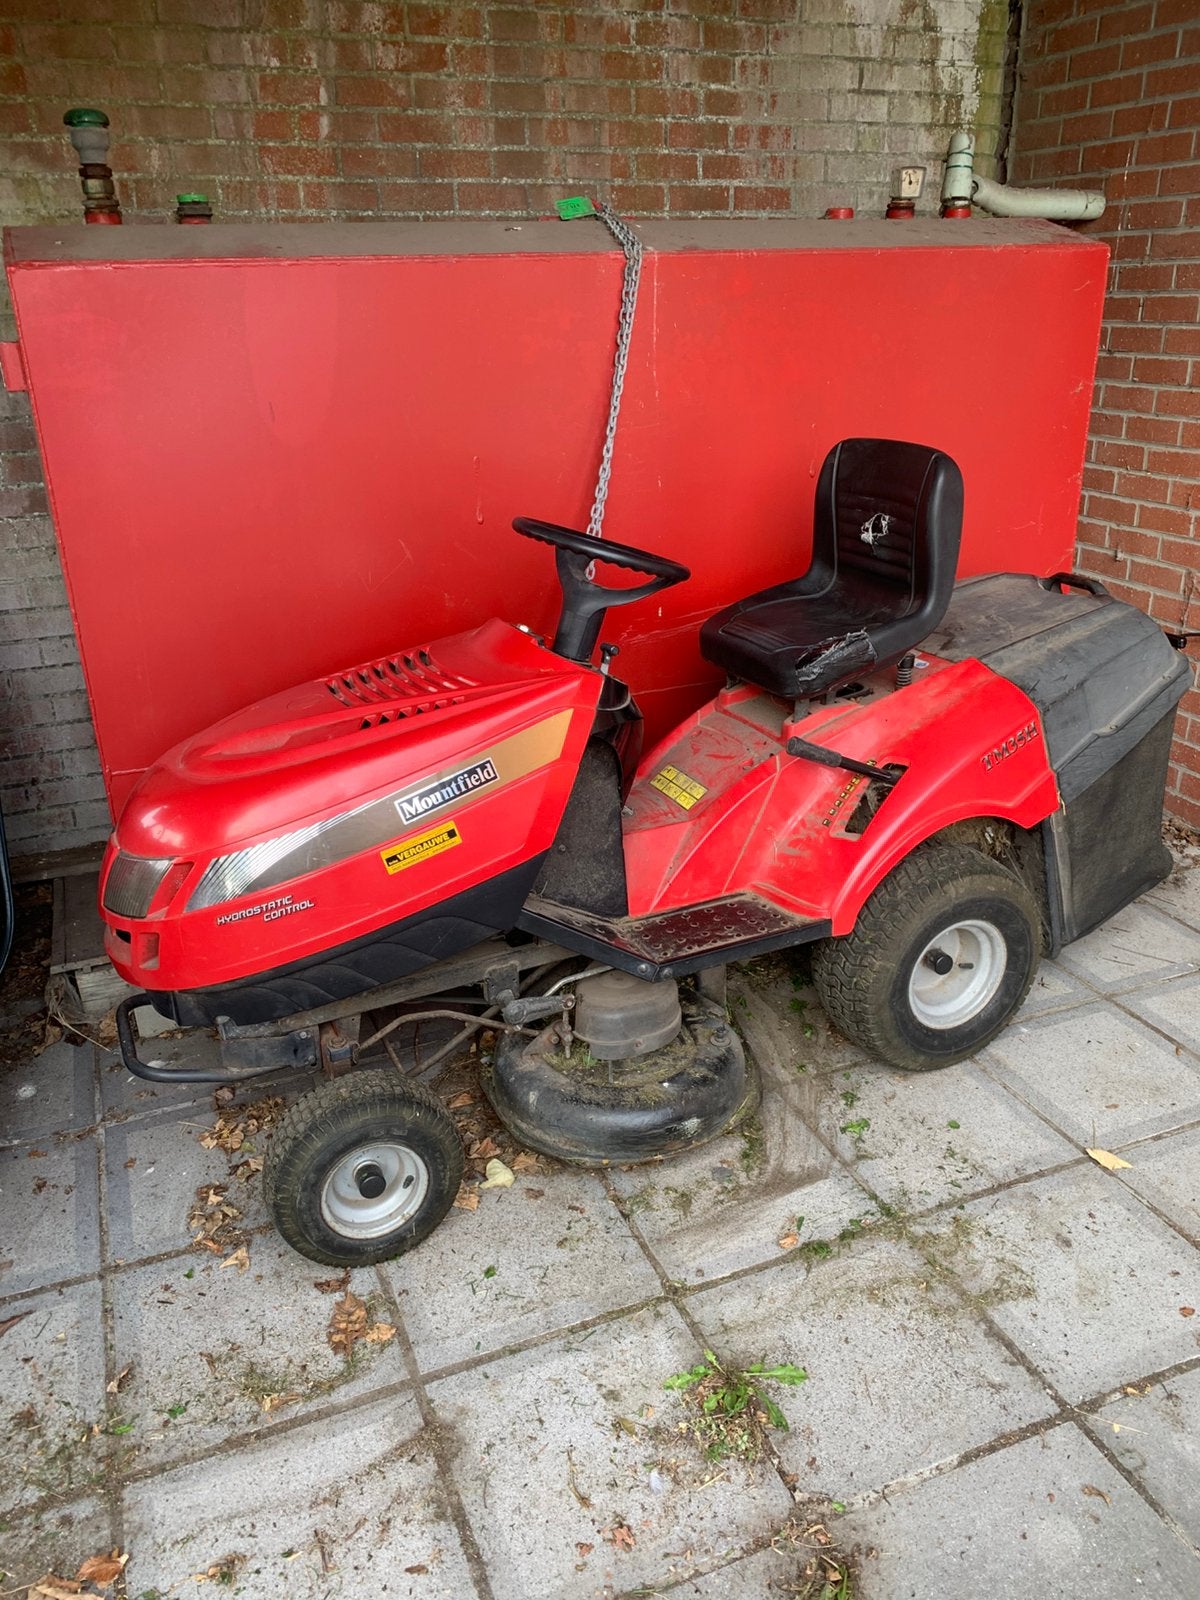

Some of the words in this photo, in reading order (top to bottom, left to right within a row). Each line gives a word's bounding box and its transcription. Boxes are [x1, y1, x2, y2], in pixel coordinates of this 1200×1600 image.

[400, 763, 496, 819] Mountfield
[396, 832, 450, 861] VERGAUWE
[217, 895, 293, 925] HYDROSTATIC
[263, 900, 315, 922] CONTROL
